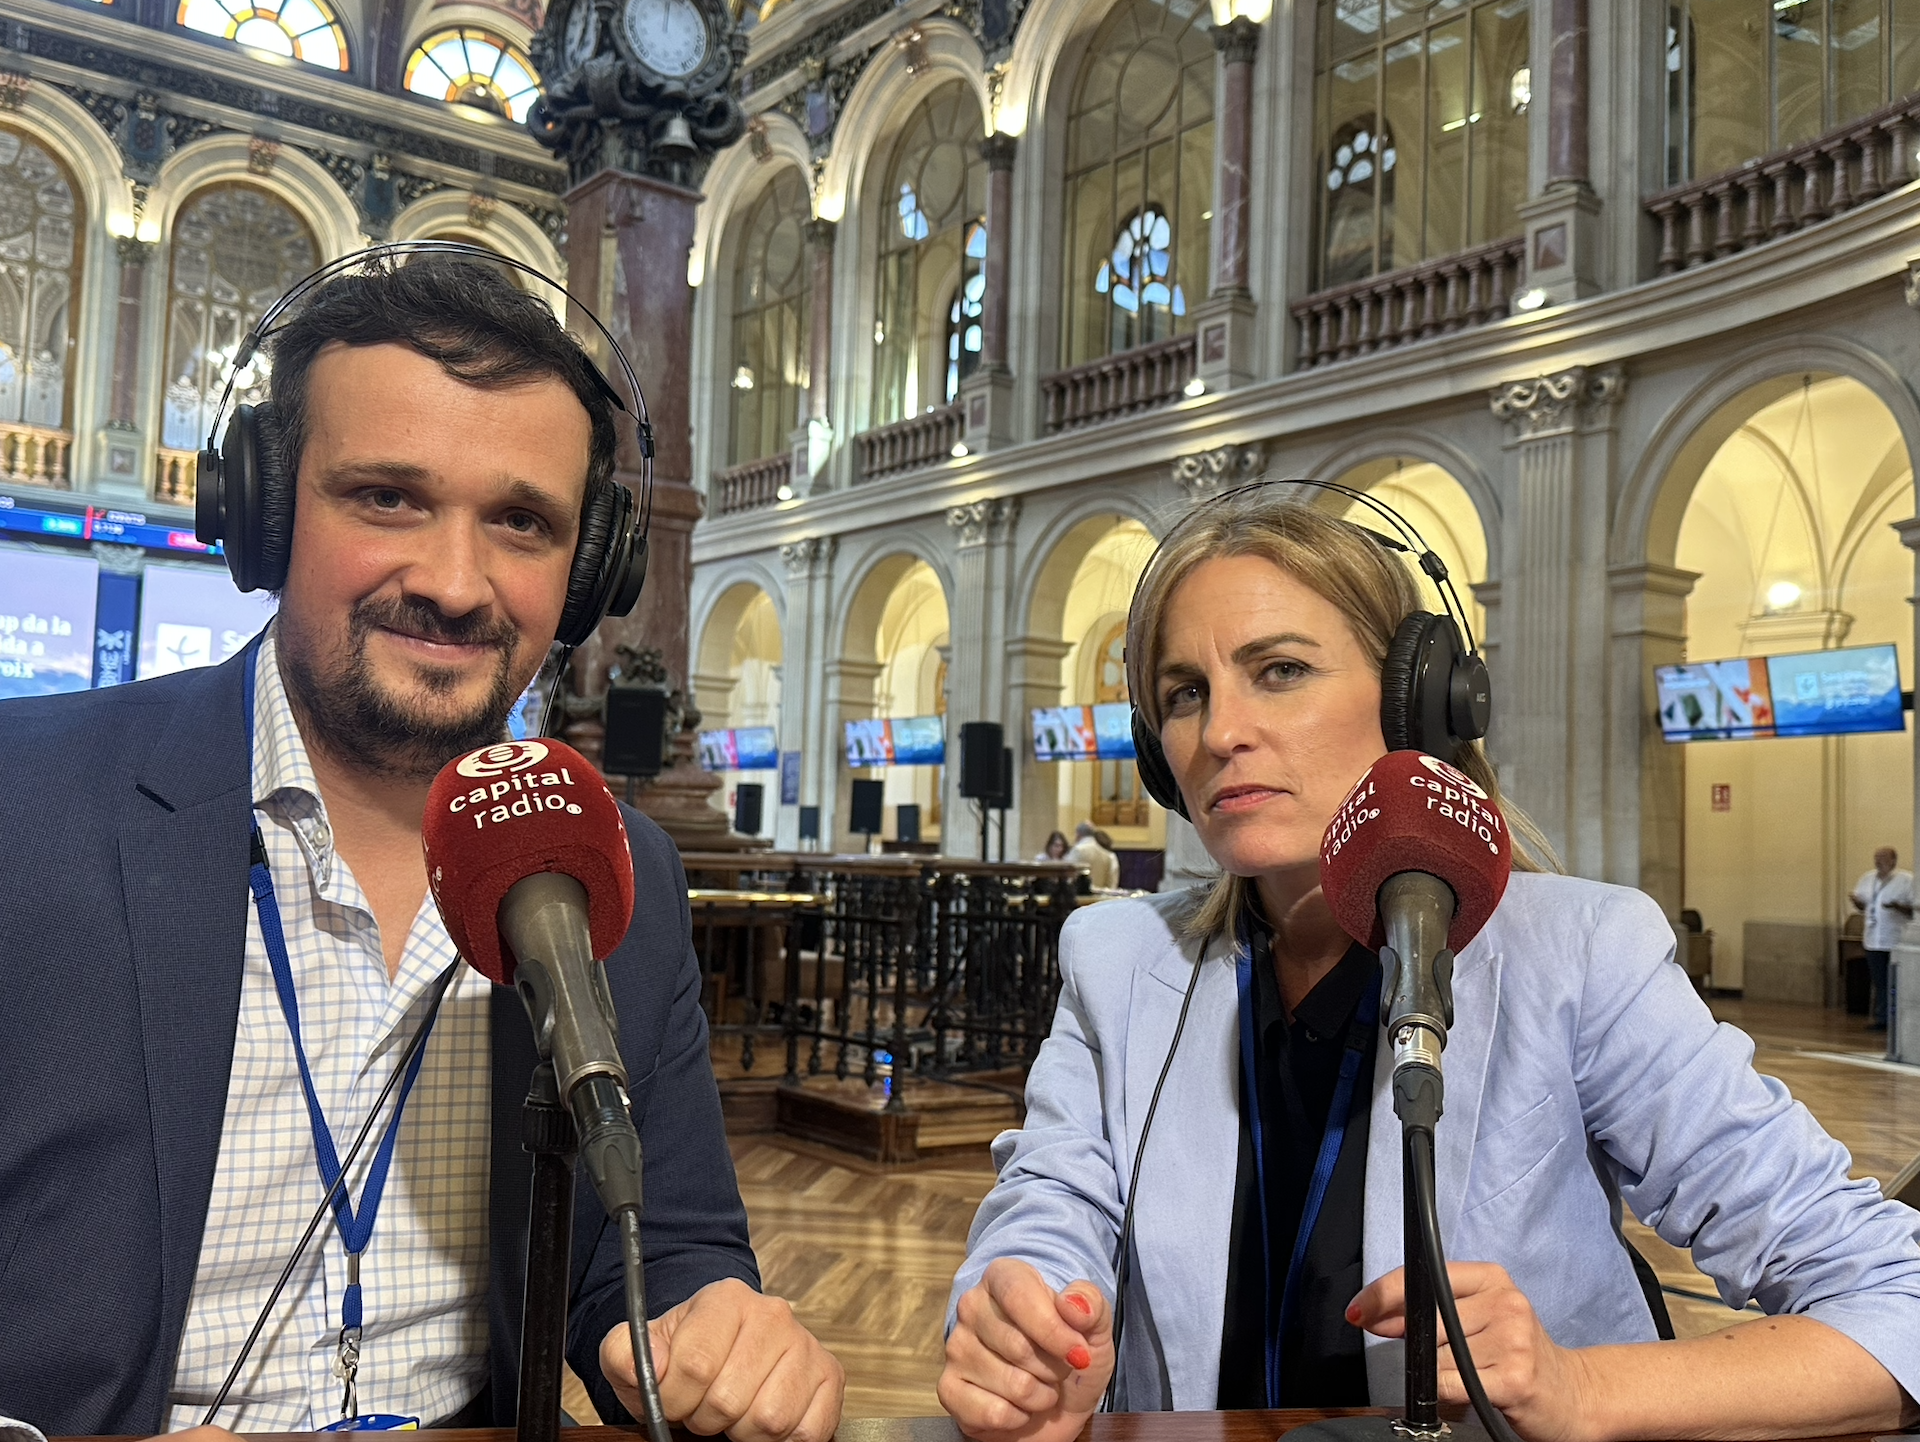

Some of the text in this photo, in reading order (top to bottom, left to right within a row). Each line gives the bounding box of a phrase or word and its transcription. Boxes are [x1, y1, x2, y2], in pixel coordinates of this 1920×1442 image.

[52, 615, 72, 636] la
[449, 768, 575, 812] capital
[1410, 776, 1502, 833] capital
[1322, 781, 1376, 850] apital
